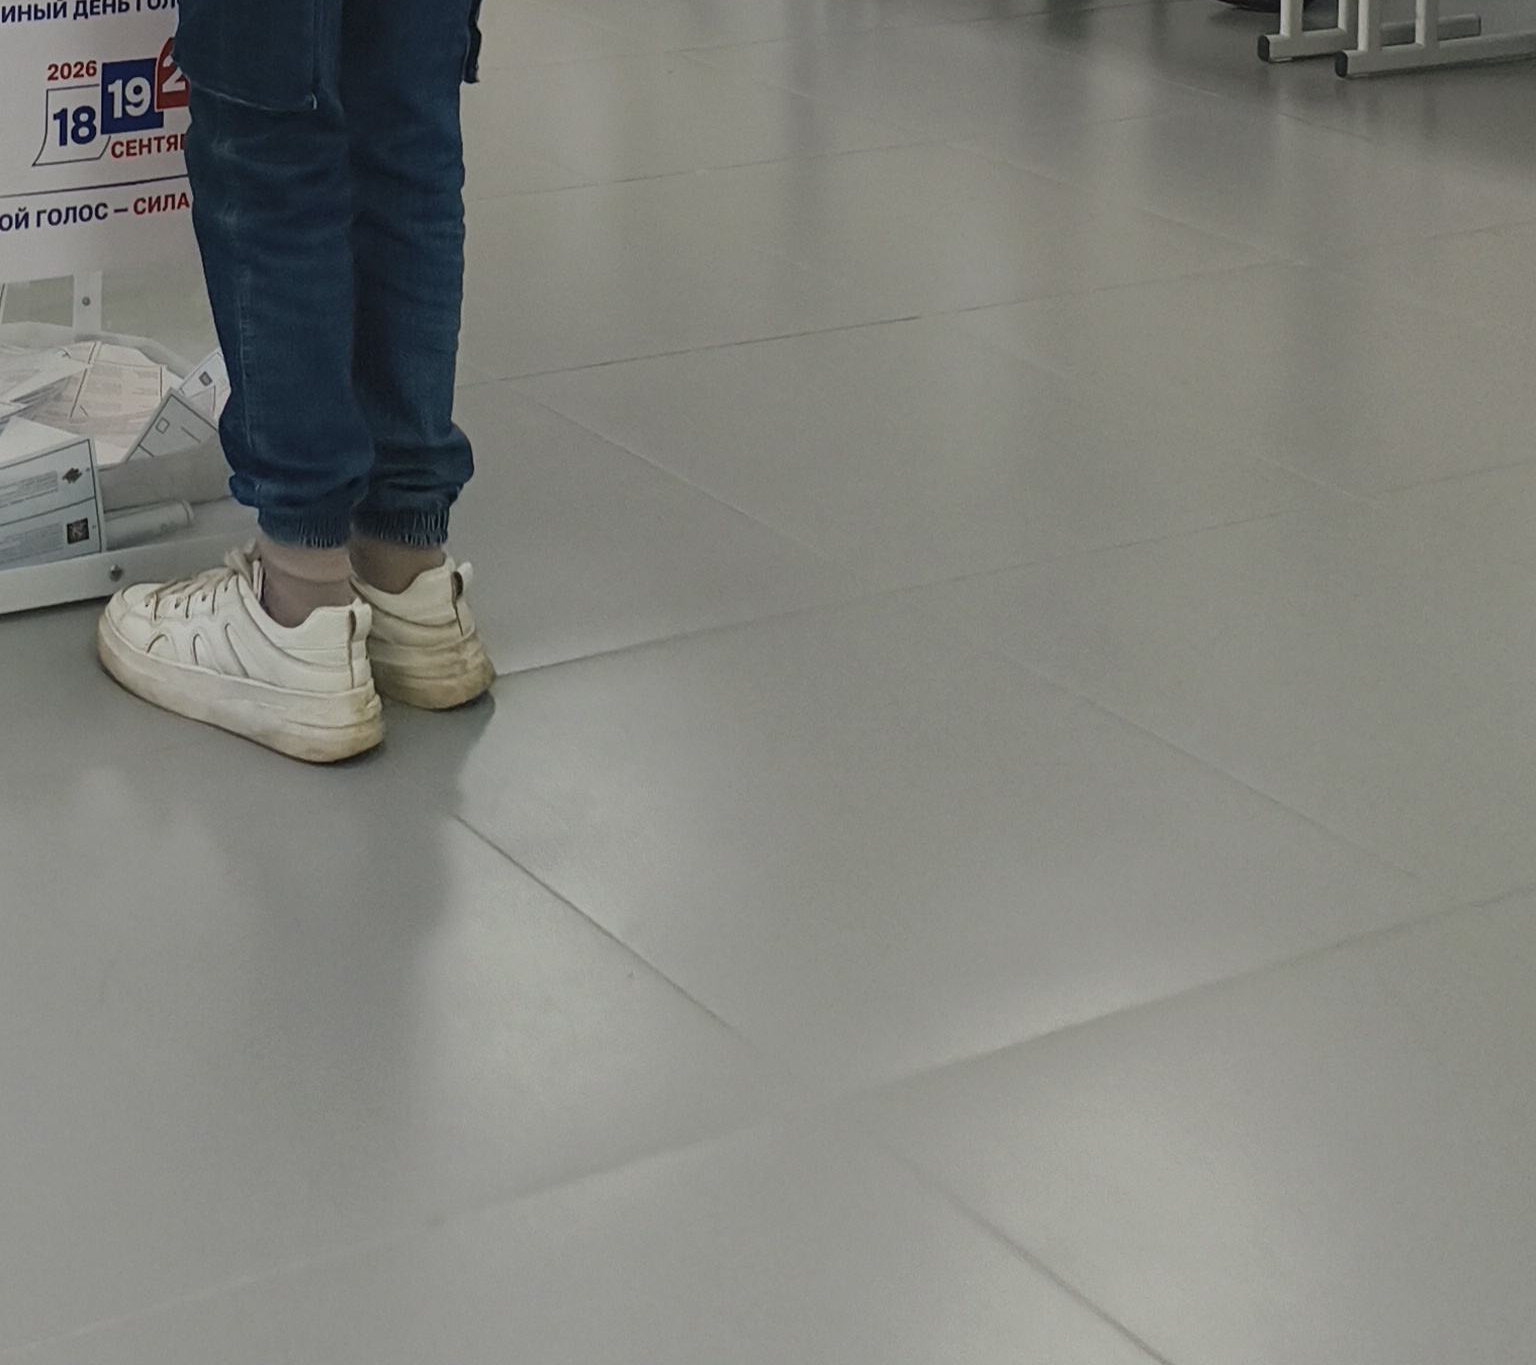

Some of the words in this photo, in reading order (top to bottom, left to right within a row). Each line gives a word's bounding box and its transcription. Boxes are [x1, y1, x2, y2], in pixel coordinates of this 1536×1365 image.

[47, 60, 97, 81] 2026
[53, 105, 97, 147] 18
[107, 76, 152, 119] 19
[161, 53, 189, 93] 2
[36, 202, 109, 228] ГОЛОС
[132, 192, 190, 216] СИЛА
